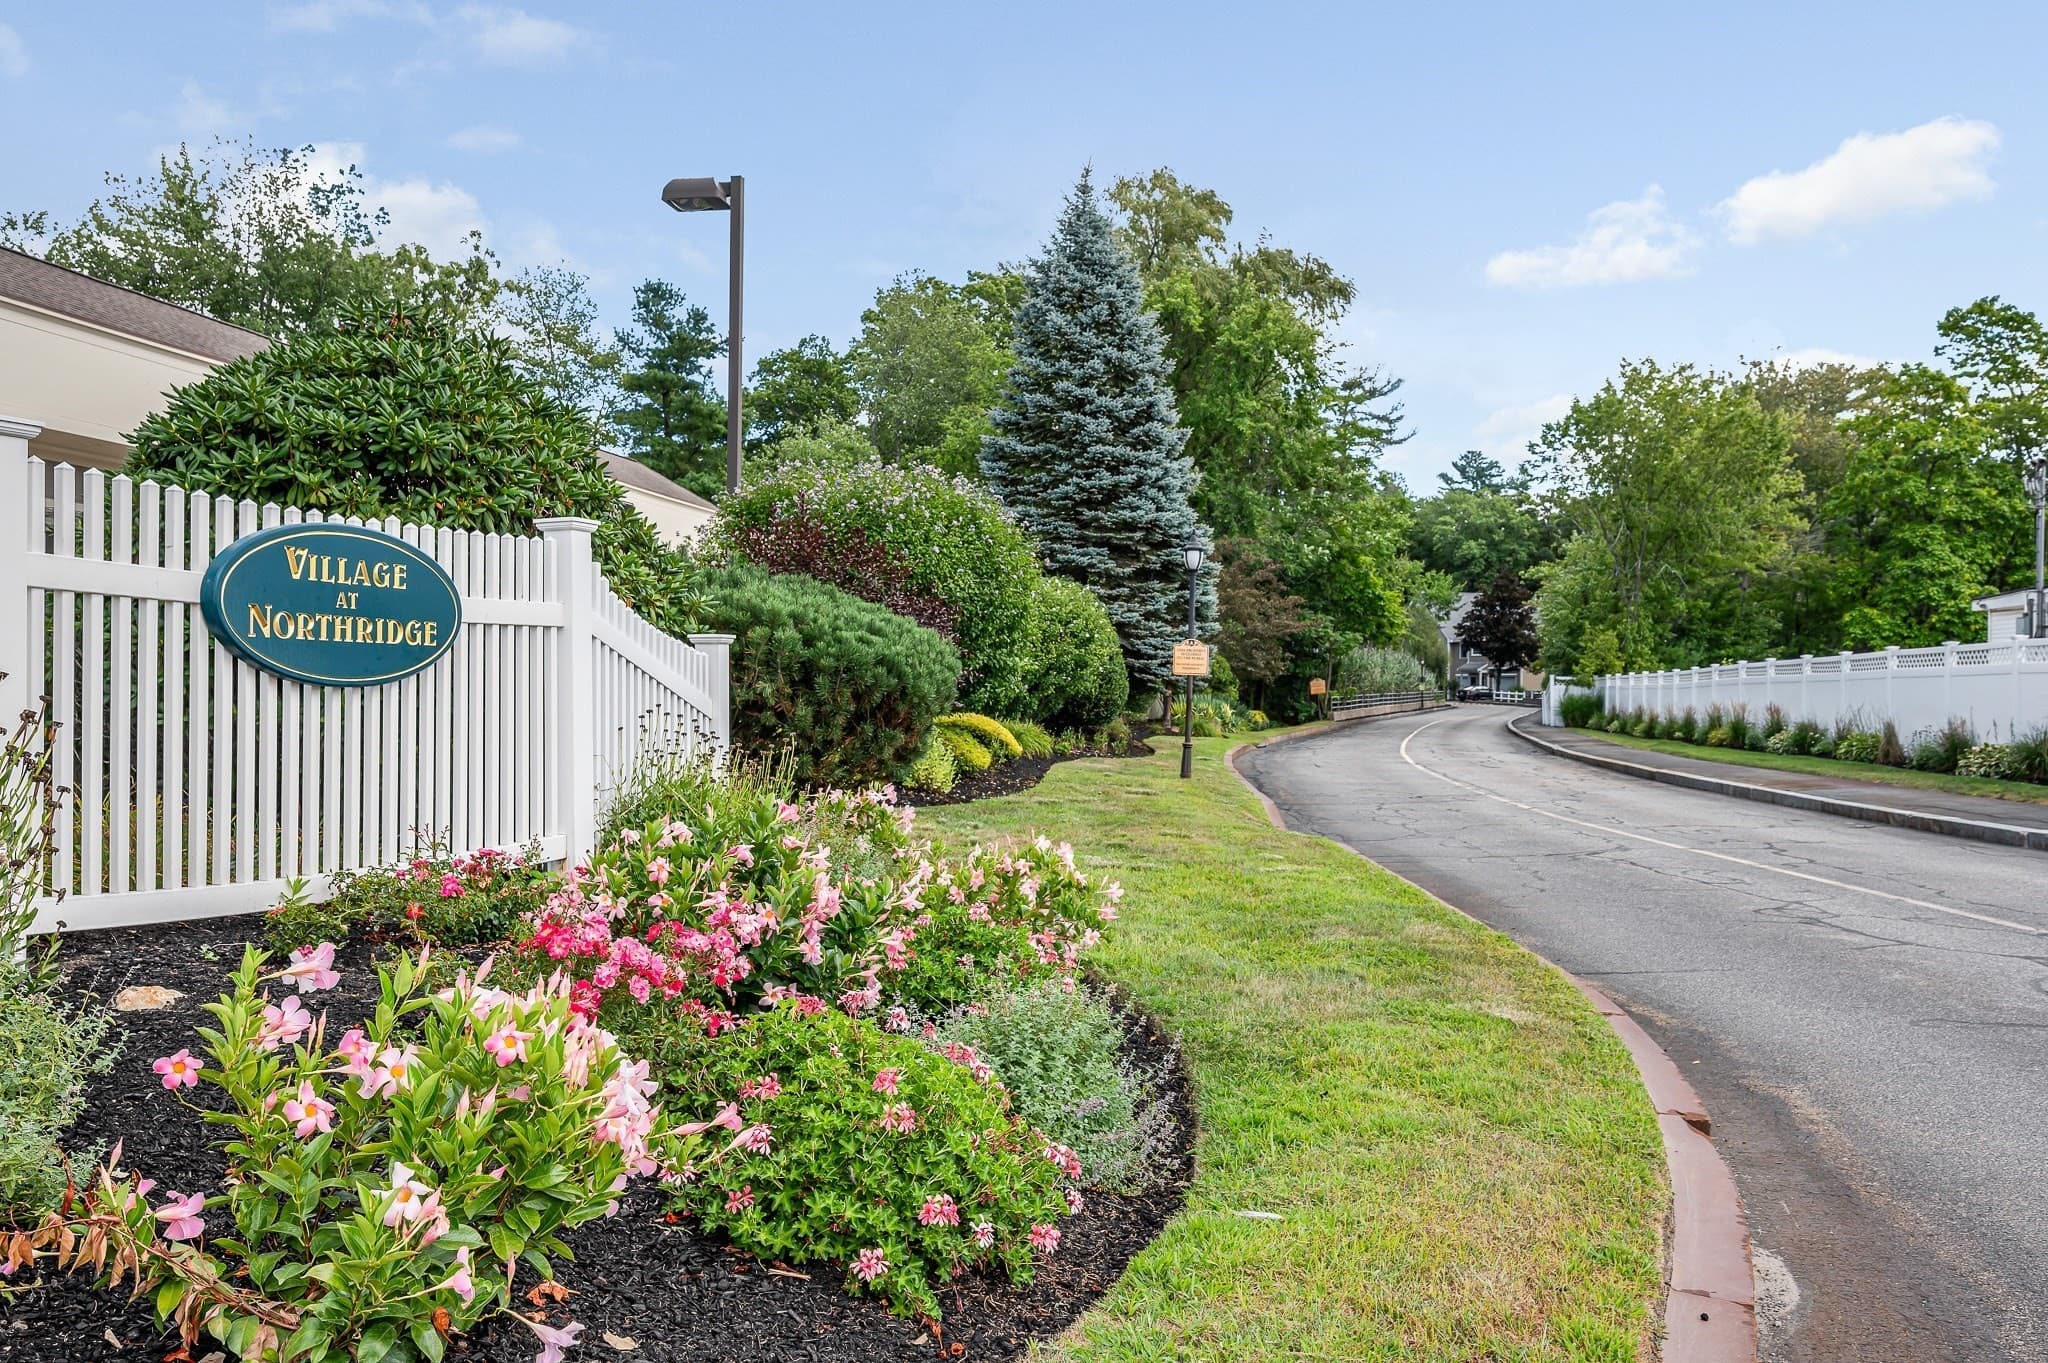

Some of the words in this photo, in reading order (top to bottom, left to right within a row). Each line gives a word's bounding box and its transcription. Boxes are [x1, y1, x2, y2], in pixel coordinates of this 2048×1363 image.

[284, 545, 408, 590] VILLAGE
[336, 591, 358, 610] AT
[247, 602, 438, 647] NORTHRIDGE
